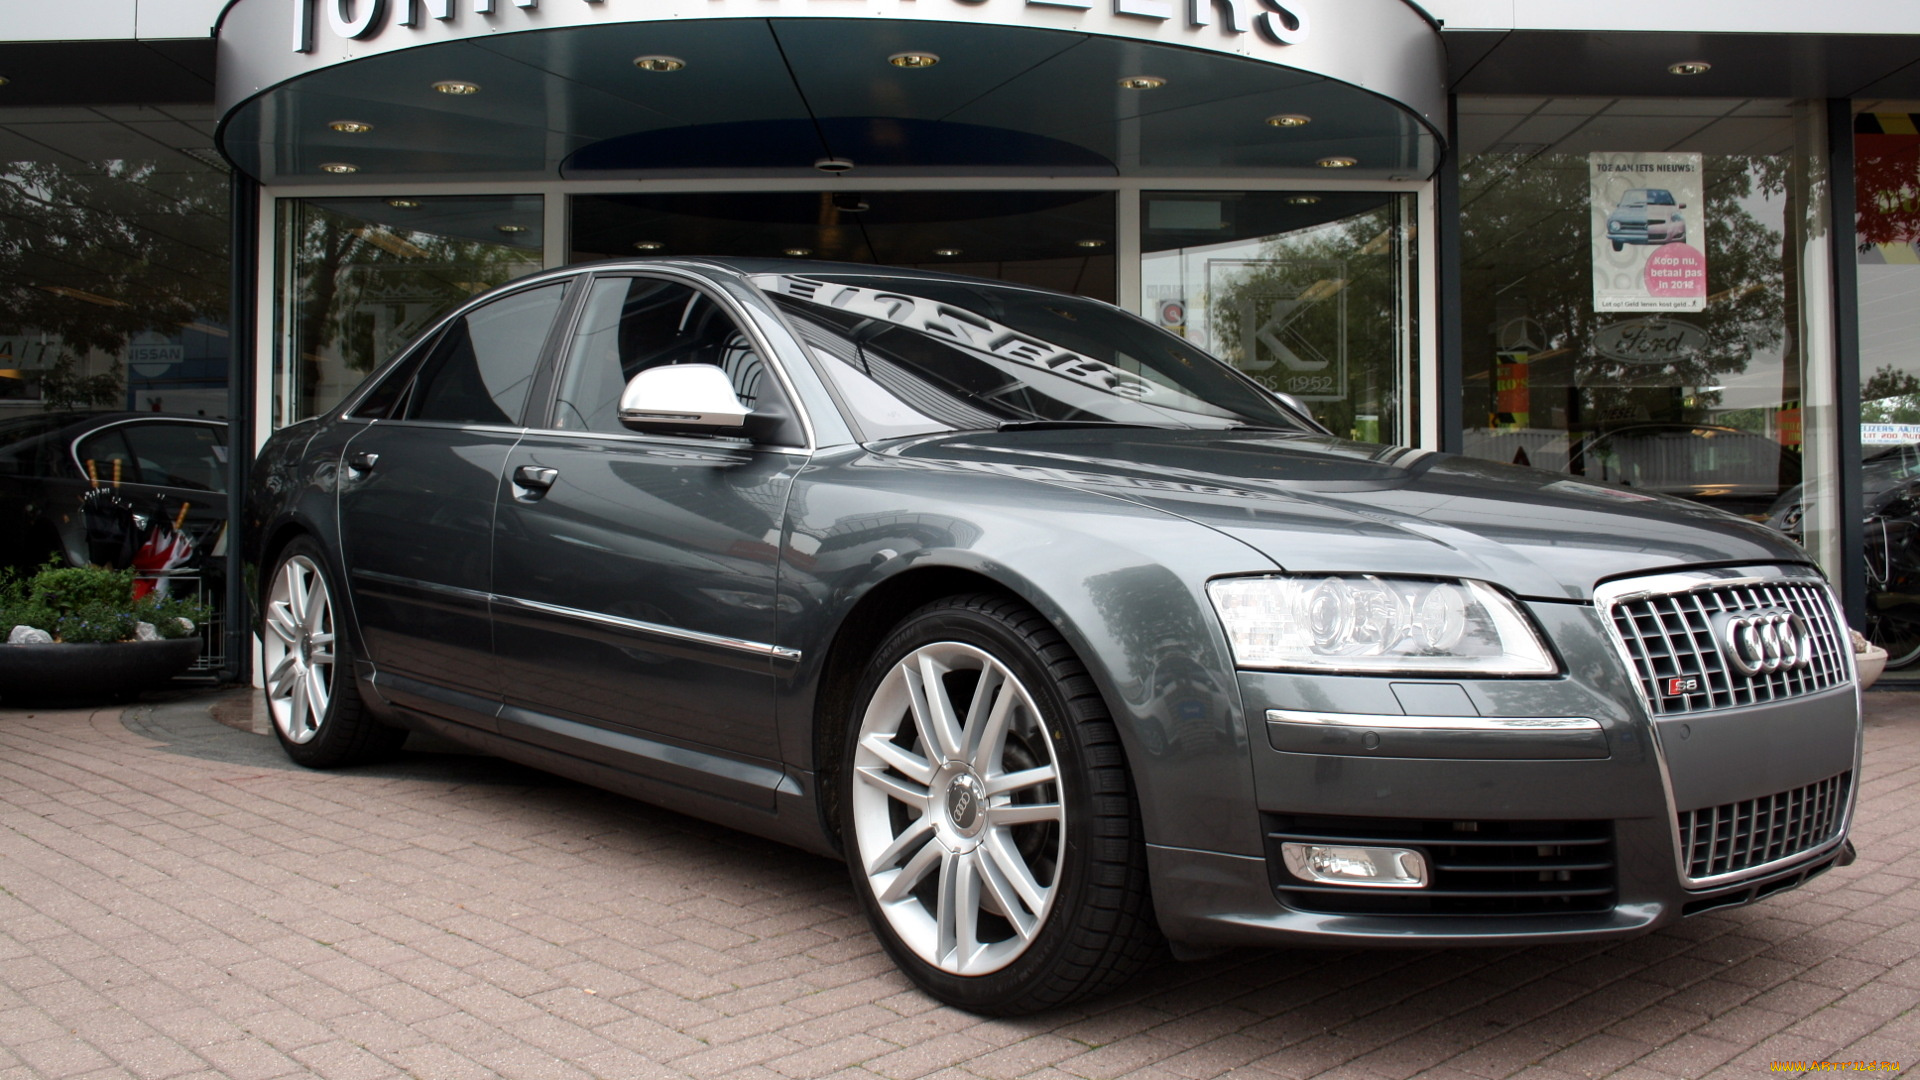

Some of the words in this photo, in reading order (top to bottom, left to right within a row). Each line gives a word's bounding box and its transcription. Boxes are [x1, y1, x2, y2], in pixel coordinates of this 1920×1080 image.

[1615, 163, 1633, 172] AAN
[1635, 163, 1654, 172] IETS
[1654, 256, 1679, 266] Koop
[1682, 257, 1698, 266] nu,
[1651, 269, 1682, 277] betaal
[1685, 269, 1702, 279] pas
[1658, 280, 1669, 289] in
[1673, 301, 1687, 309] geld
[1616, 325, 1685, 354] Ford
[127, 348, 181, 360] NISSAN
[1285, 376, 1333, 393] 1952
